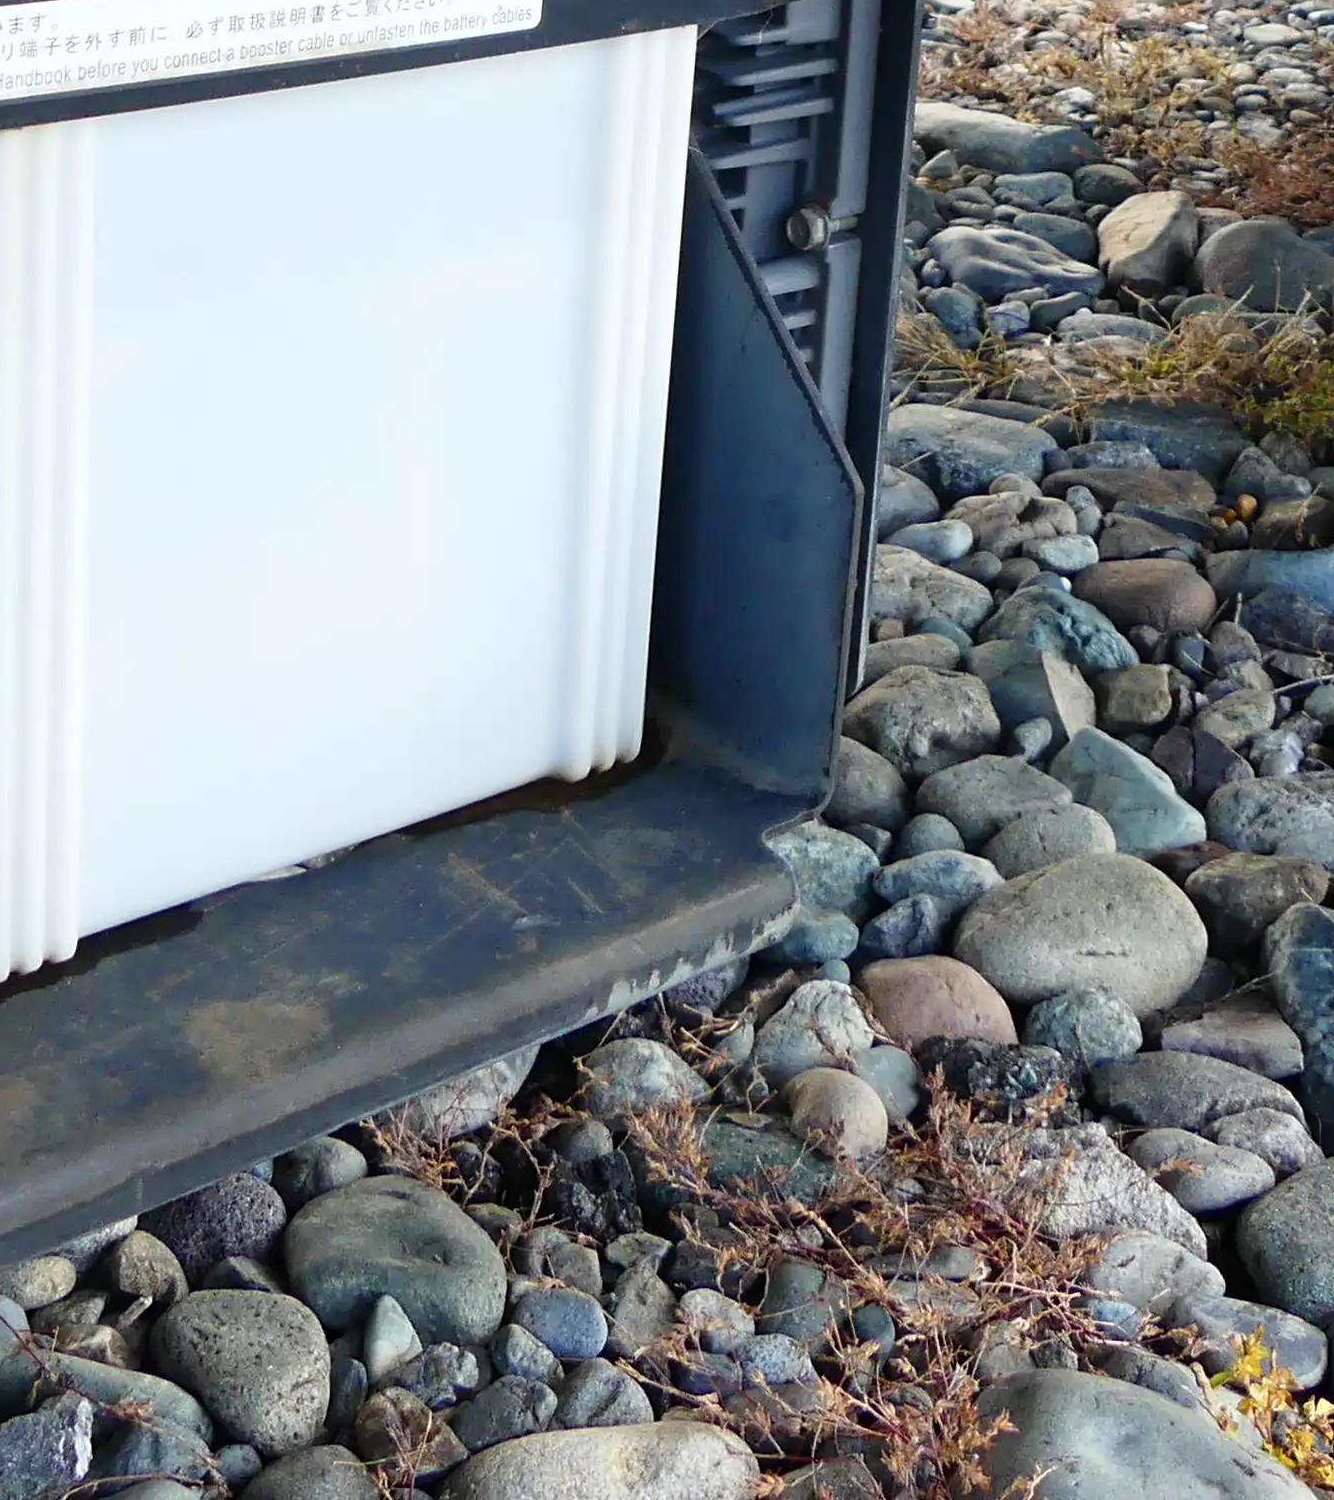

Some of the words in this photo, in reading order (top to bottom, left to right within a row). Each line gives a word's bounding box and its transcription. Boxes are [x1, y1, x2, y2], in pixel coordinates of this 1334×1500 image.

[78, 59, 127, 81] before
[131, 56, 159, 79] you
[164, 48, 222, 70] connect
[226, 46, 236, 62] a
[240, 37, 293, 60] booster
[298, 31, 336, 53] cable
[340, 32, 353, 47] or
[358, 22, 416, 45] unfasten
[419, 17, 440, 35] the
[444, 13, 488, 32] battery
